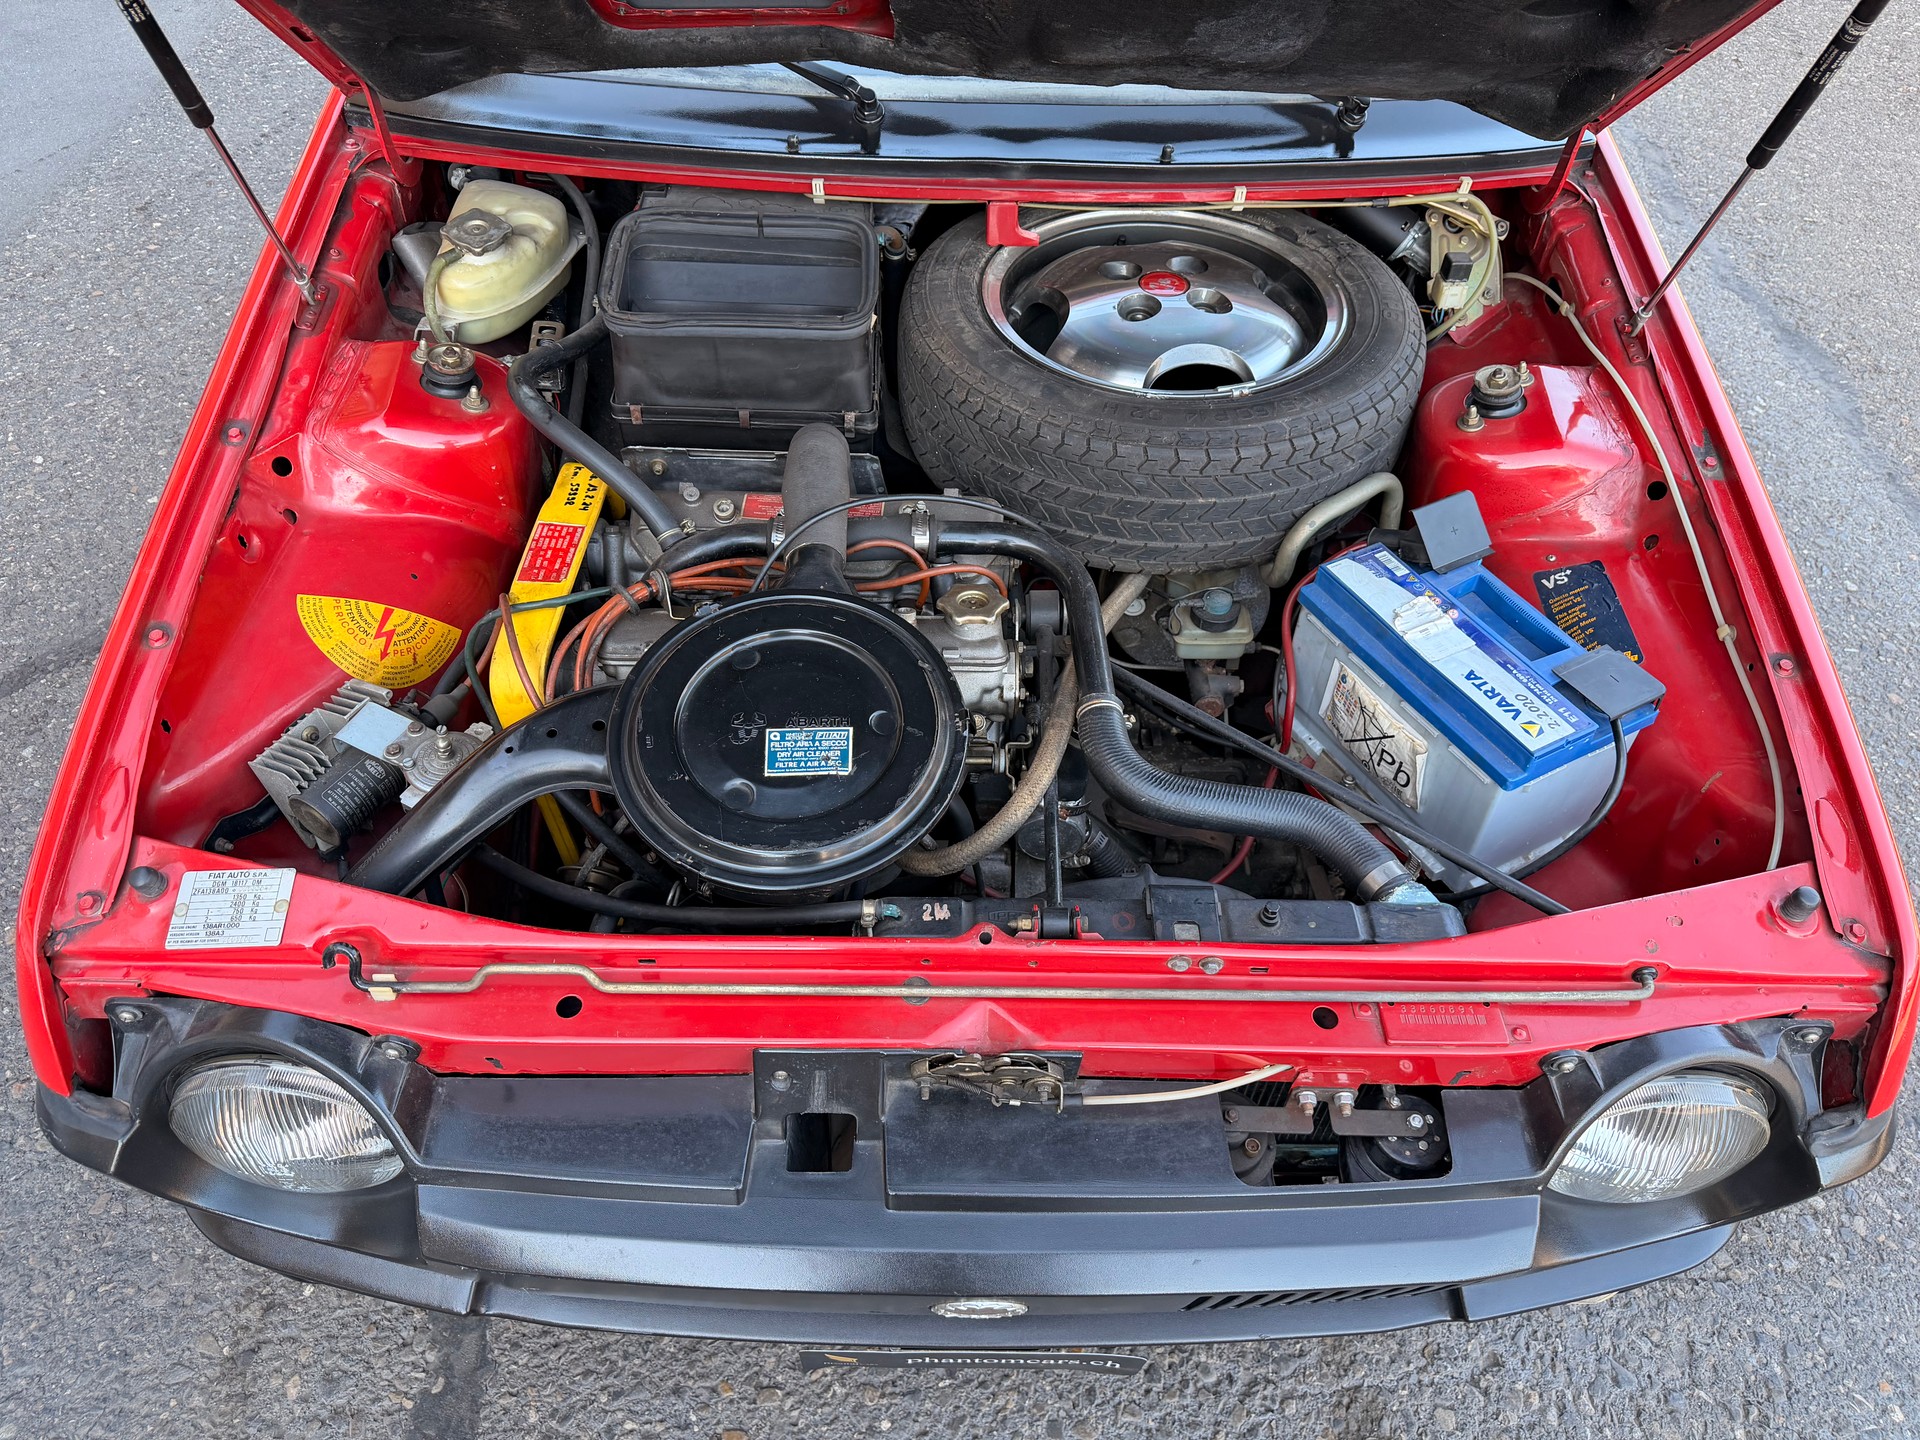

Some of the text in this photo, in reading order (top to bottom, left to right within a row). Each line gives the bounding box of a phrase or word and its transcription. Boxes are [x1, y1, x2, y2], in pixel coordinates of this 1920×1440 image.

[1568, 603, 1586, 614] engine
[1580, 616, 1596, 626] Motor
[1464, 669, 1522, 721] VARTA
[1514, 694, 1560, 730] 2.2020
[1558, 707, 1580, 723] E11
[786, 716, 851, 728] ABARTH
[815, 732, 848, 740] FIAT
[1376, 748, 1410, 788] Pb
[208, 872, 226, 880] FIAT
[1400, 1005, 1475, 1014] 33860891
[906, 1356, 1121, 1370] phantomcars.ch
